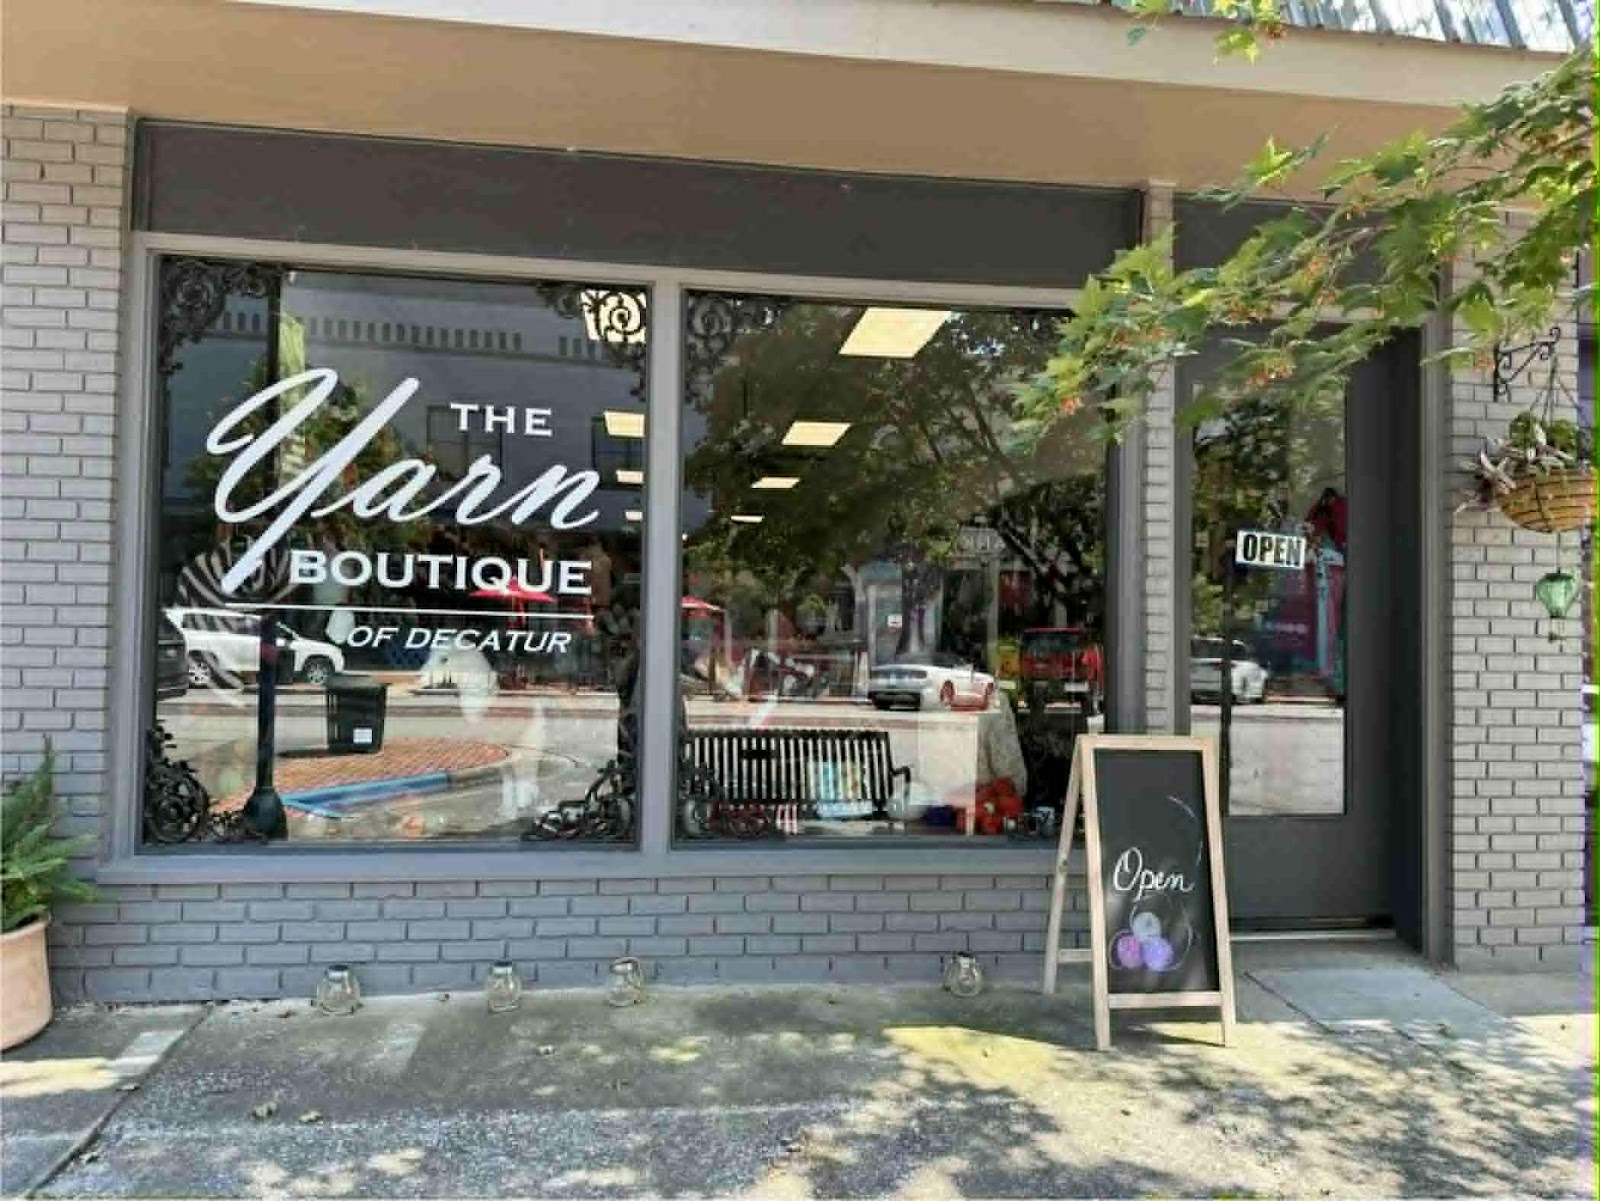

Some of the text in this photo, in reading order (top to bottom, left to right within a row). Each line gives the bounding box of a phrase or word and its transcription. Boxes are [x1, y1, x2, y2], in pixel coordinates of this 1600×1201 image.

[450, 402, 553, 436] THE
[206, 367, 600, 595] Yarn
[1242, 534, 1303, 566] OPEN
[289, 549, 593, 595] BOUTIQUE
[346, 627, 572, 652] OF DECATUR
[1113, 846, 1195, 902] Open
